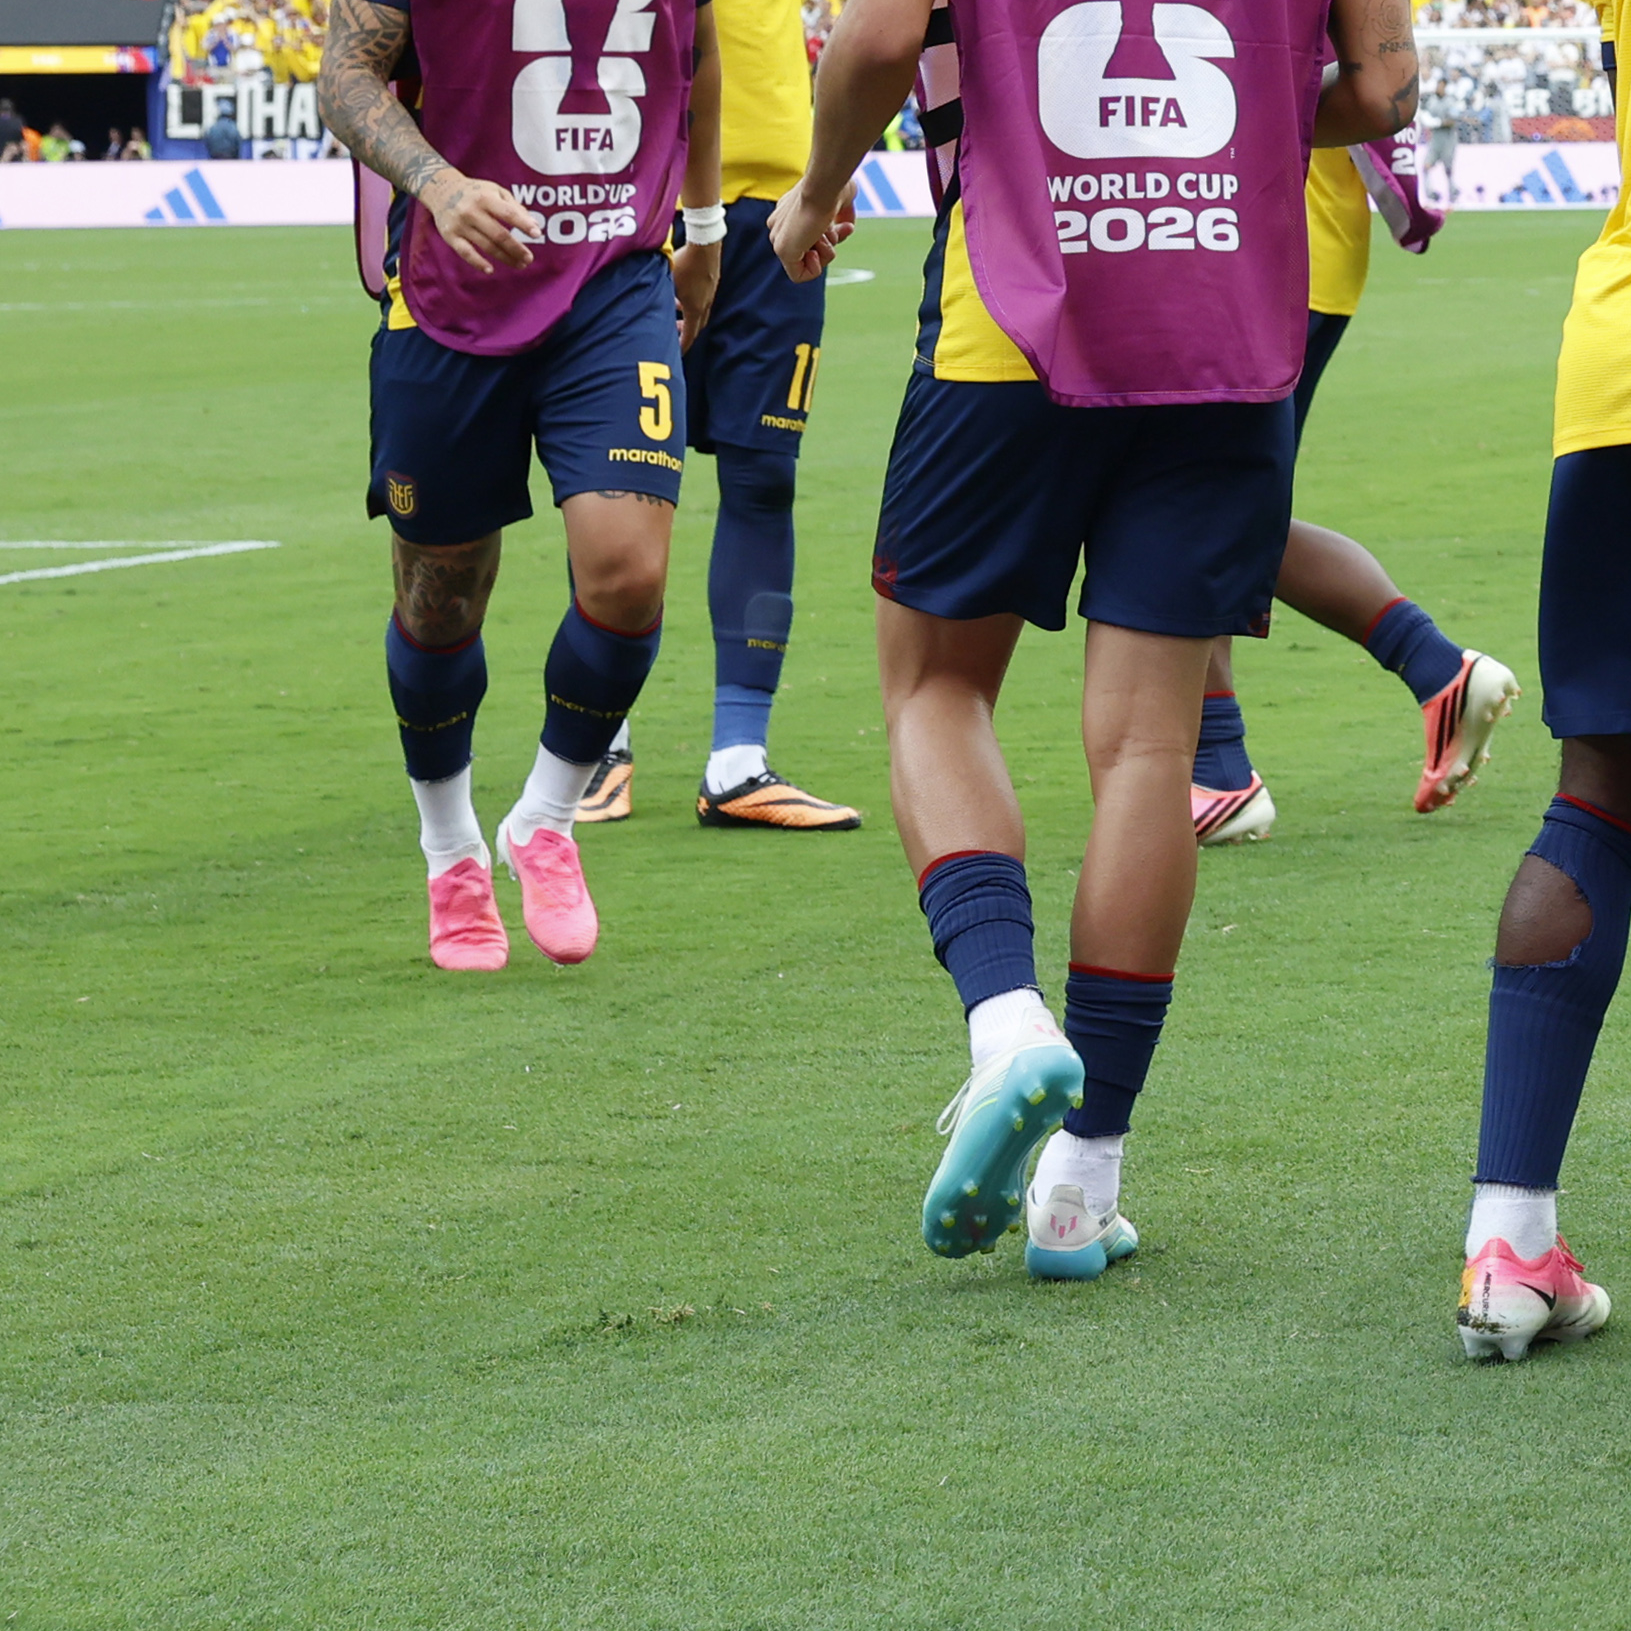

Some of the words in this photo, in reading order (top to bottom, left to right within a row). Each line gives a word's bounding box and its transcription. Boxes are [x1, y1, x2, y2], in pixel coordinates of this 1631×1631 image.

[1098, 96, 1188, 129] FIFA
[555, 127, 614, 152] FIFA
[511, 183, 606, 207] WORLD
[1047, 172, 1170, 203] WORLD
[1176, 172, 1239, 201] CUP
[1054, 206, 1241, 254] 2026
[787, 343, 821, 413] 11
[637, 361, 673, 442] 5
[608, 448, 683, 473] marathon
